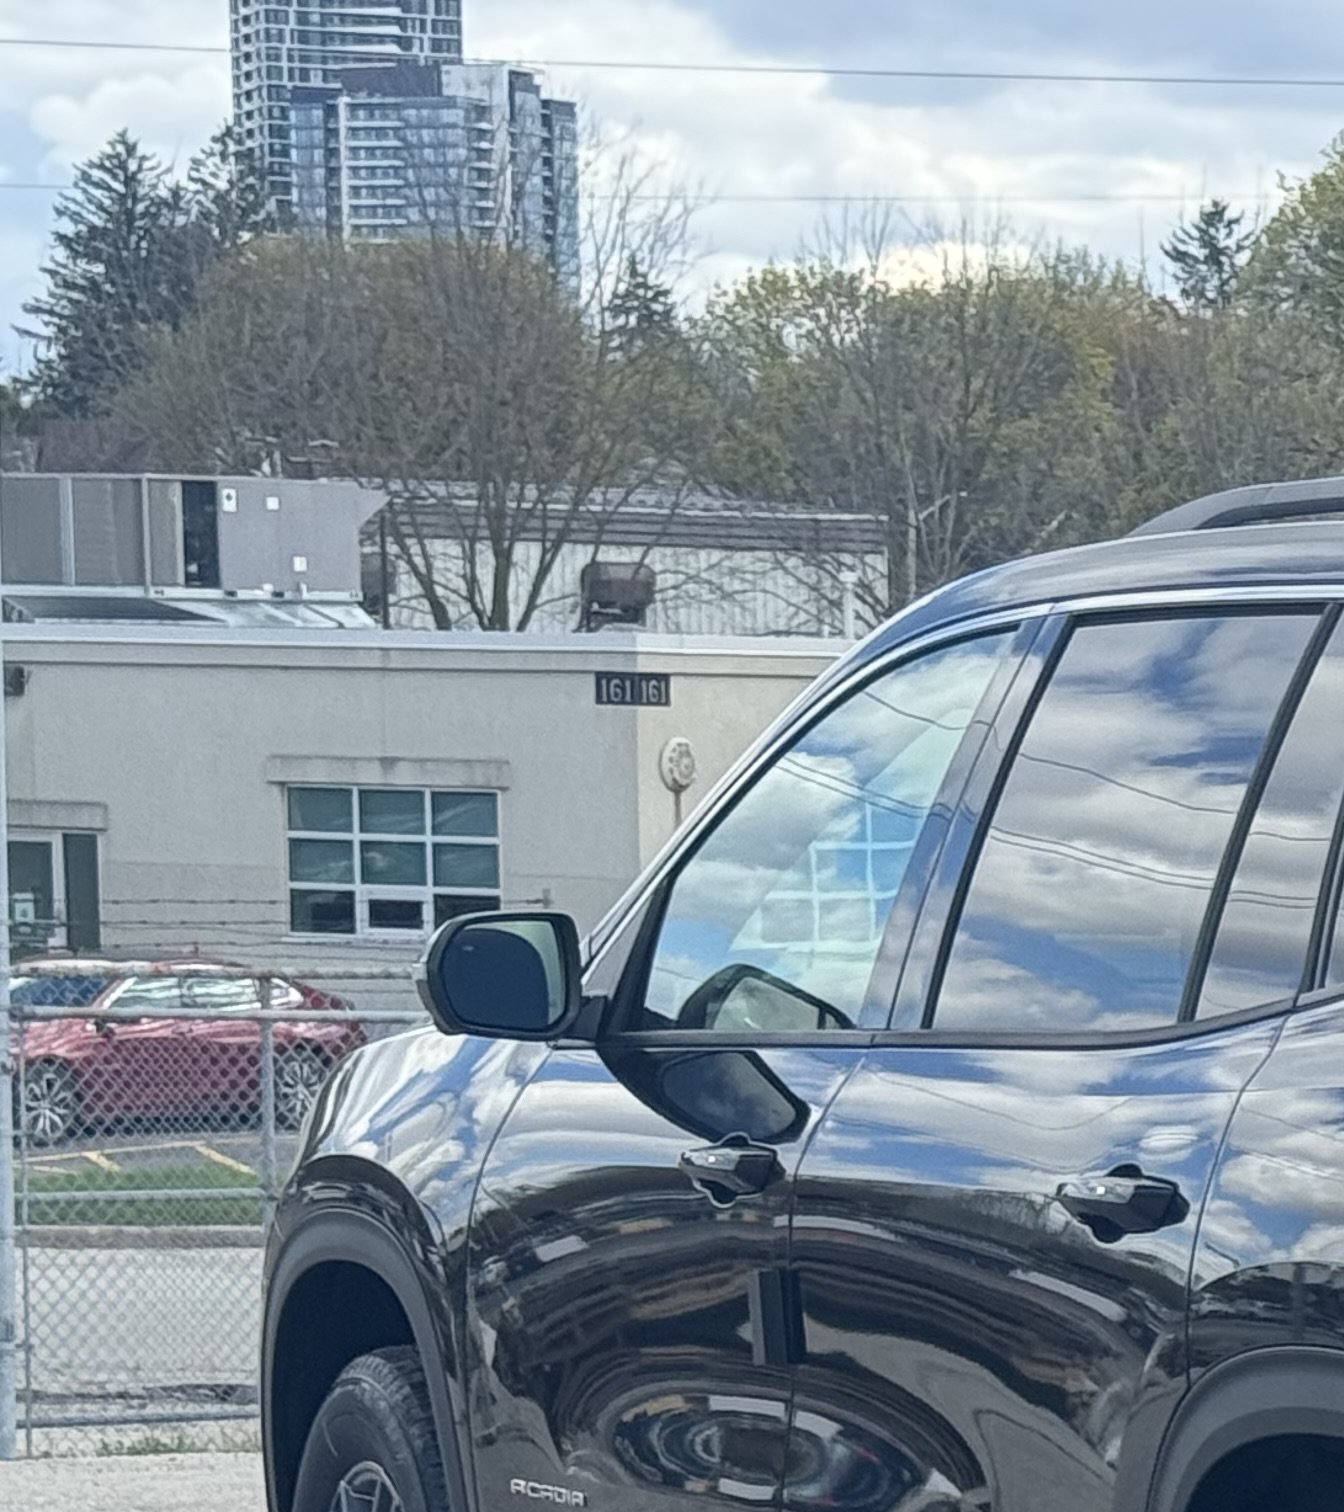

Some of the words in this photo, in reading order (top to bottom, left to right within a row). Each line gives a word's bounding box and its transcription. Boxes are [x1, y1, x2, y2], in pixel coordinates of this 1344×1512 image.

[601, 678, 632, 702] 161
[641, 679, 667, 704] 161
[510, 1478, 585, 1508] ACADIA
